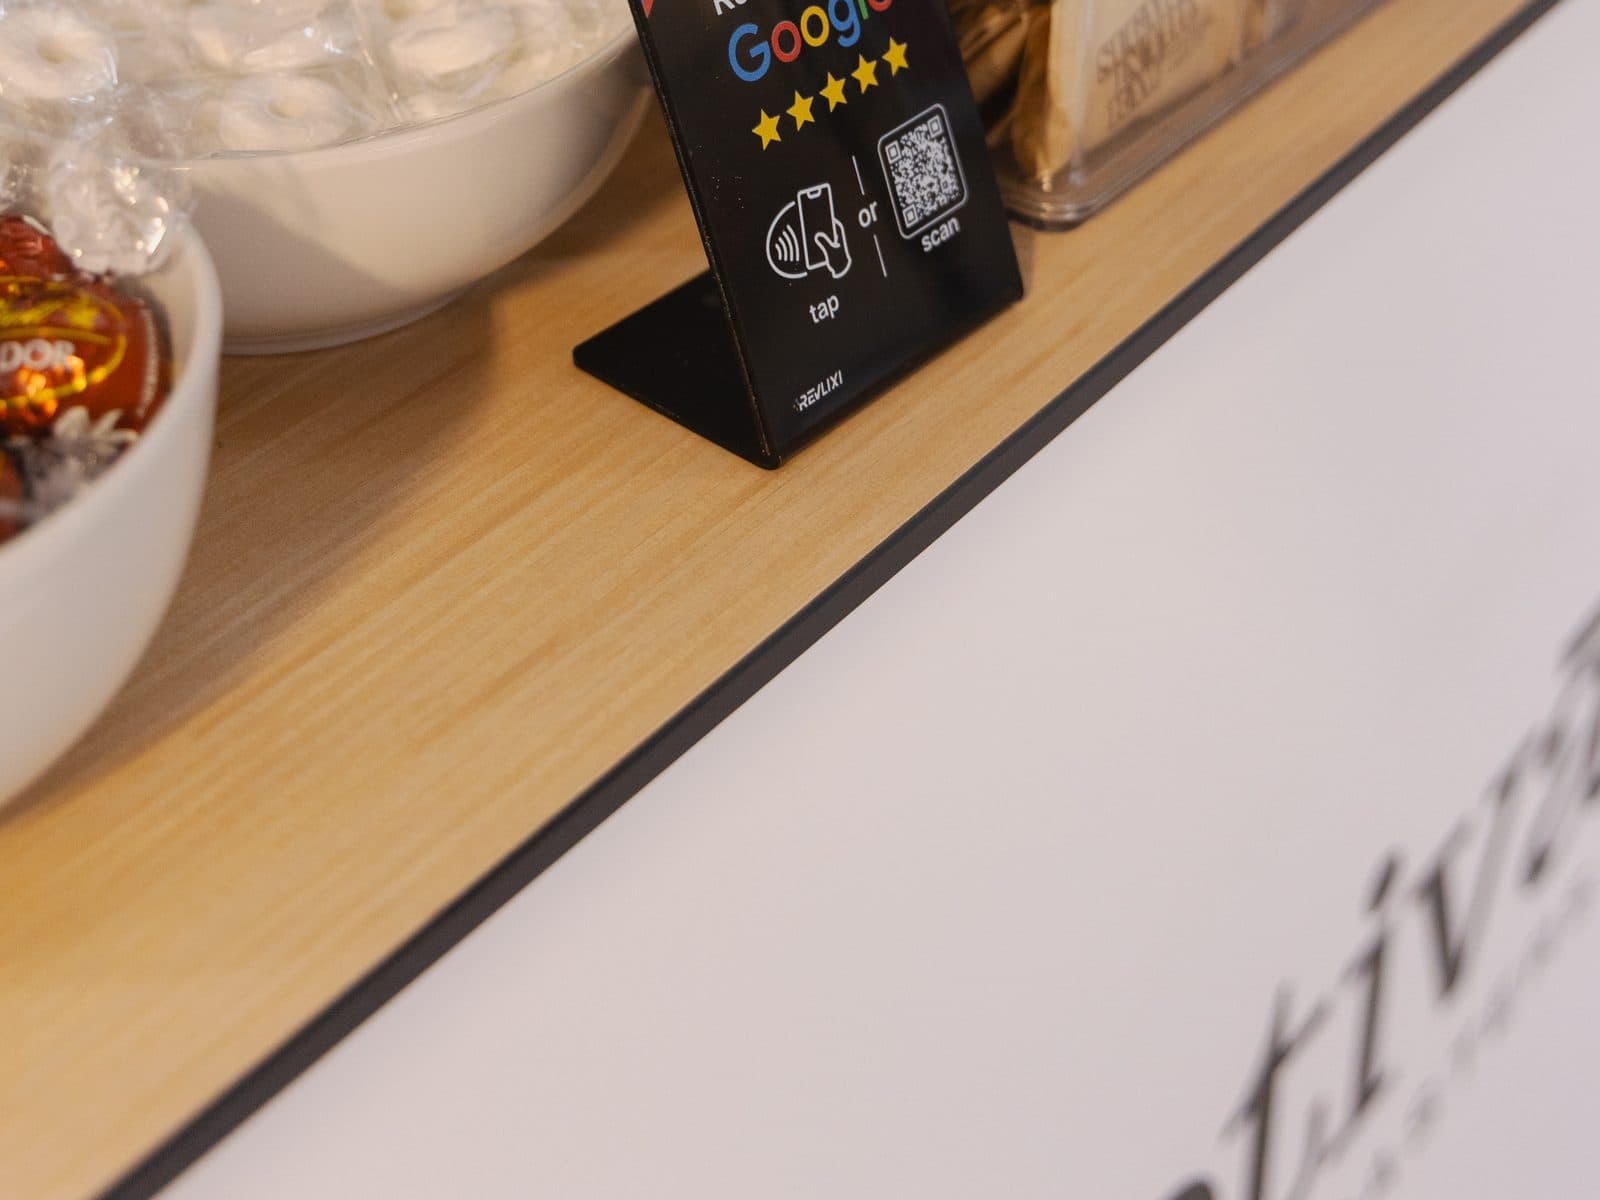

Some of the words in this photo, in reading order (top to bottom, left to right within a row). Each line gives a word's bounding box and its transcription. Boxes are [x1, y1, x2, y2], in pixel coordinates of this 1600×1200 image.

[858, 201, 878, 228] or
[921, 217, 961, 252] scan
[809, 295, 840, 323] tap
[799, 369, 843, 412] REVLIXI
